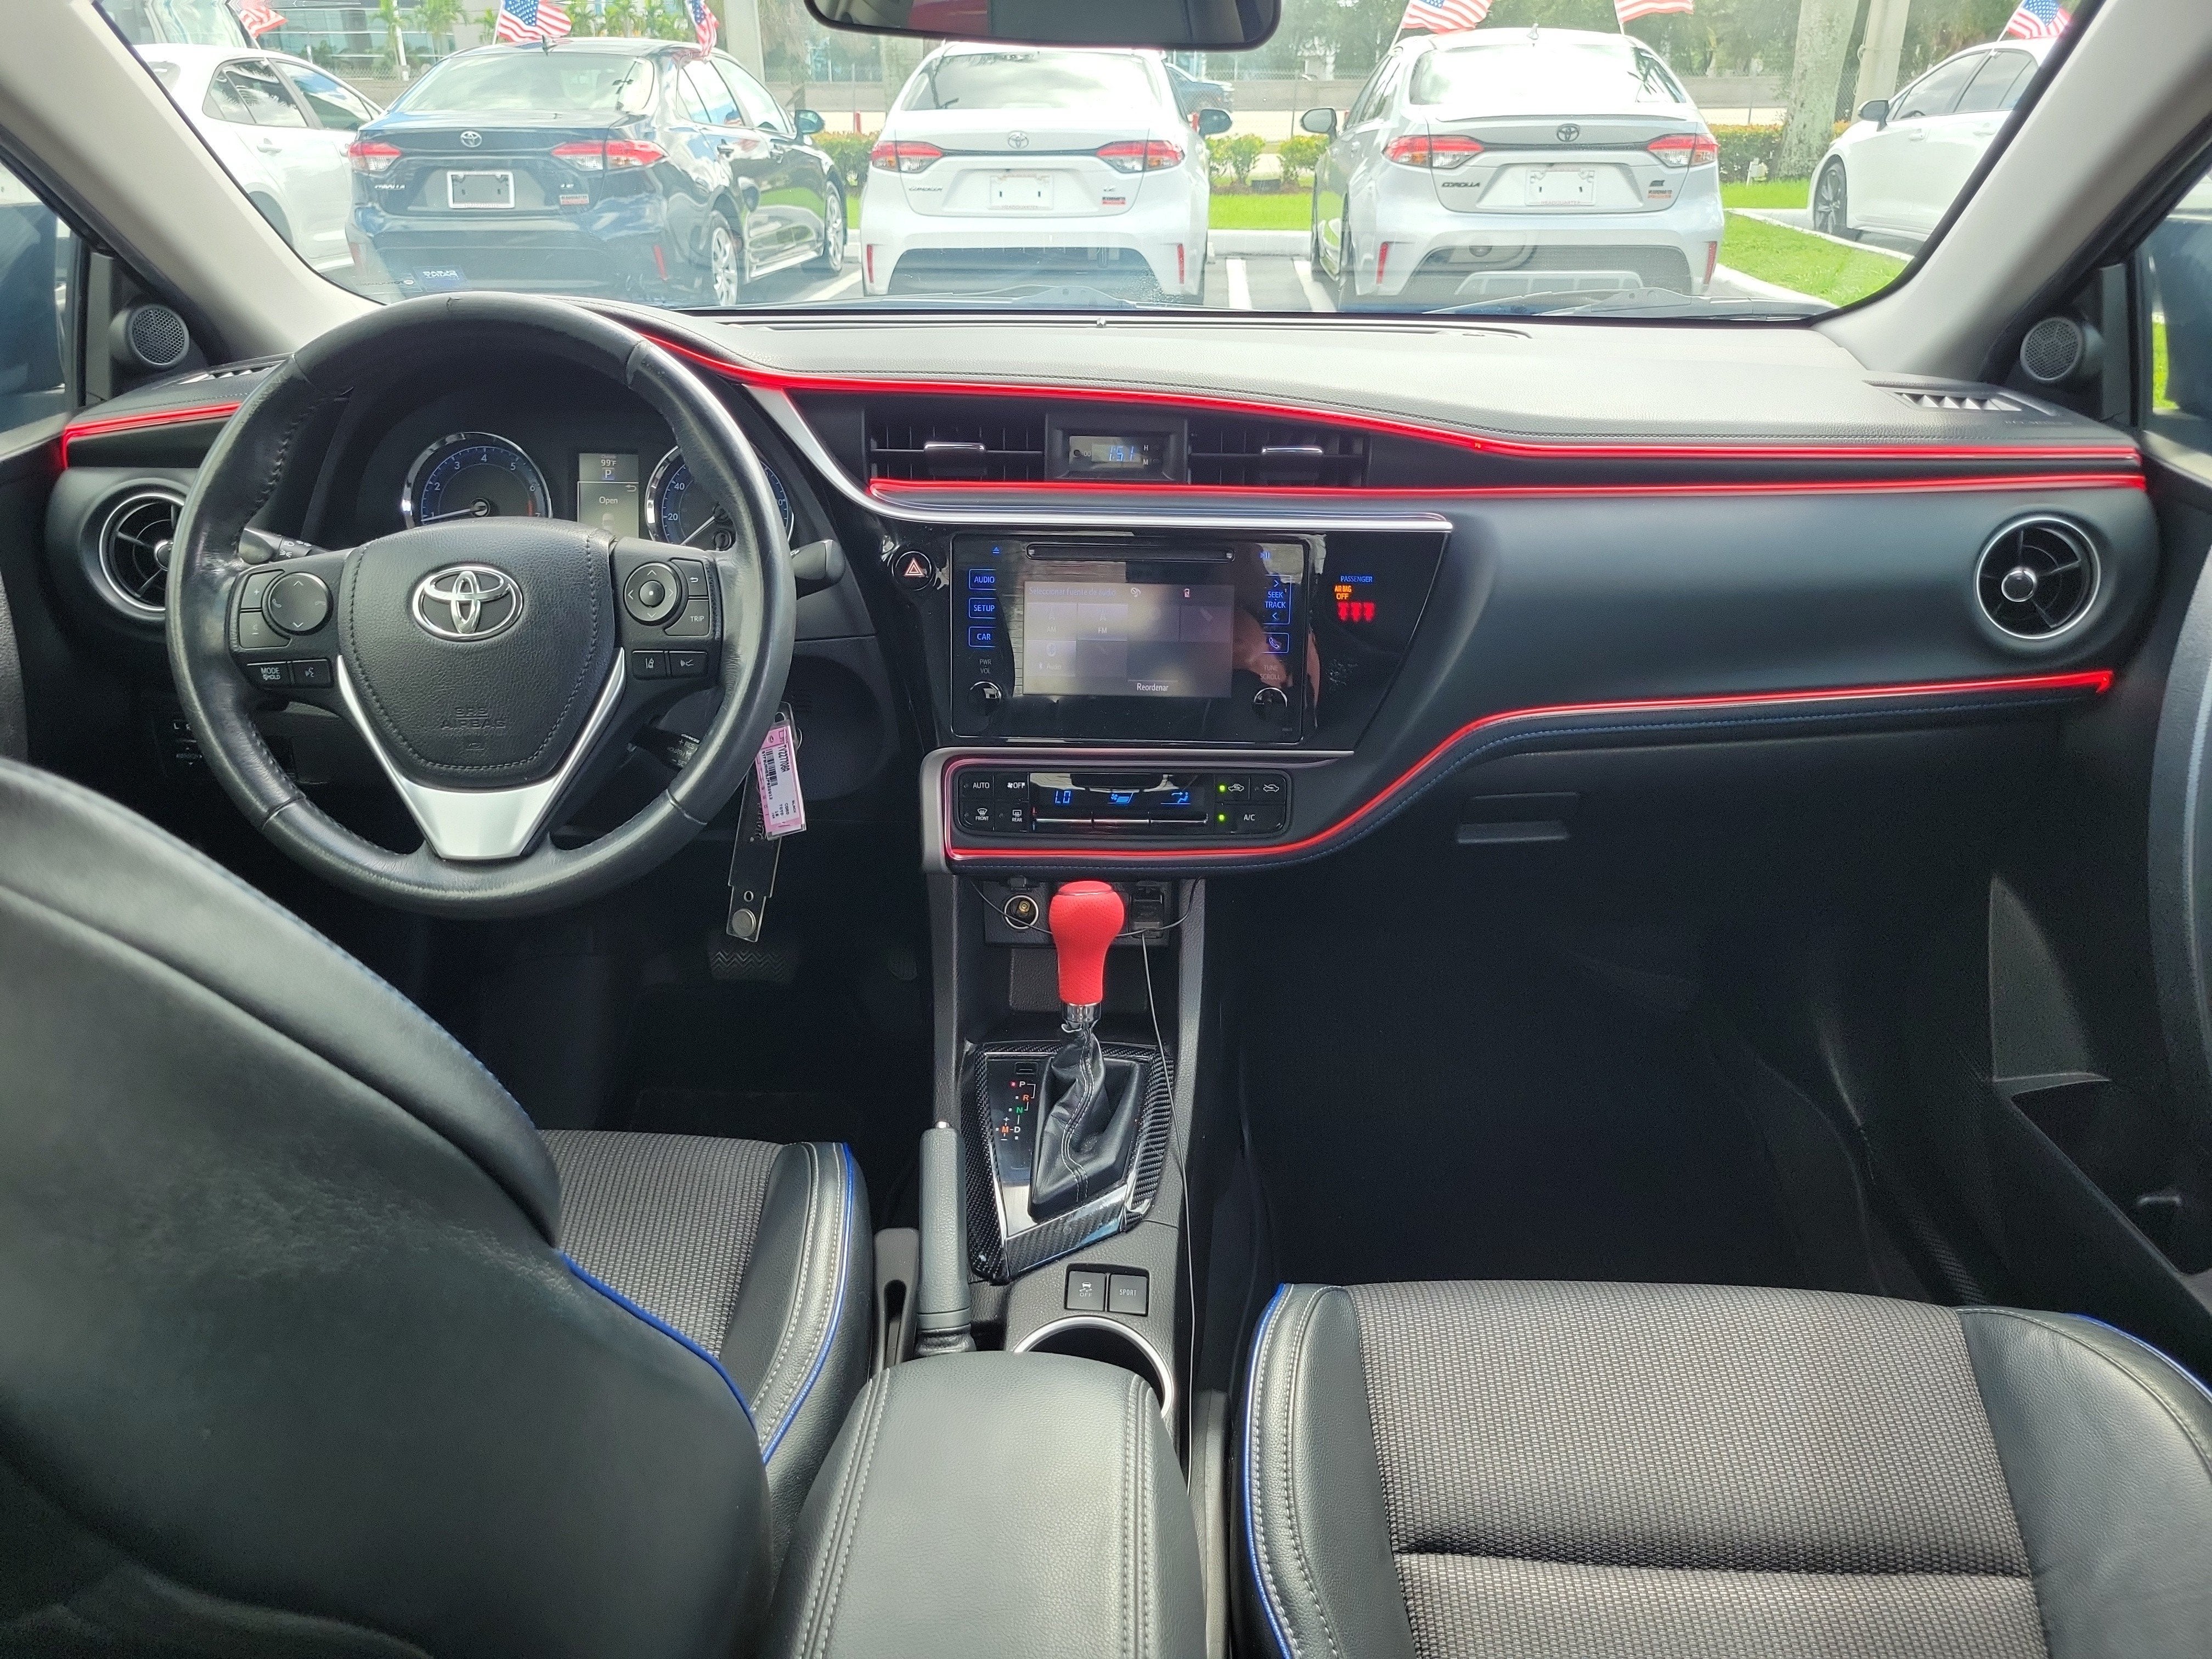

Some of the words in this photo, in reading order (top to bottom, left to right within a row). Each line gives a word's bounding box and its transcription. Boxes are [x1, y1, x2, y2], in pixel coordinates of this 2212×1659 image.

[481, 454, 488, 462] 4
[454, 461, 460, 470] 3
[510, 462, 516, 471] 5
[605, 469, 612, 478] P
[434, 482, 441, 490] 2
[529, 483, 536, 492] 6
[674, 482, 685, 490] 40
[599, 496, 618, 505] Open
[1029, 587, 1065, 596] Seleccionar
[1066, 588, 1087, 596] fuente
[1137, 682, 1169, 692] Reordenar
[441, 719, 506, 730] AIRBAG
[1054, 790, 1071, 804] LO
